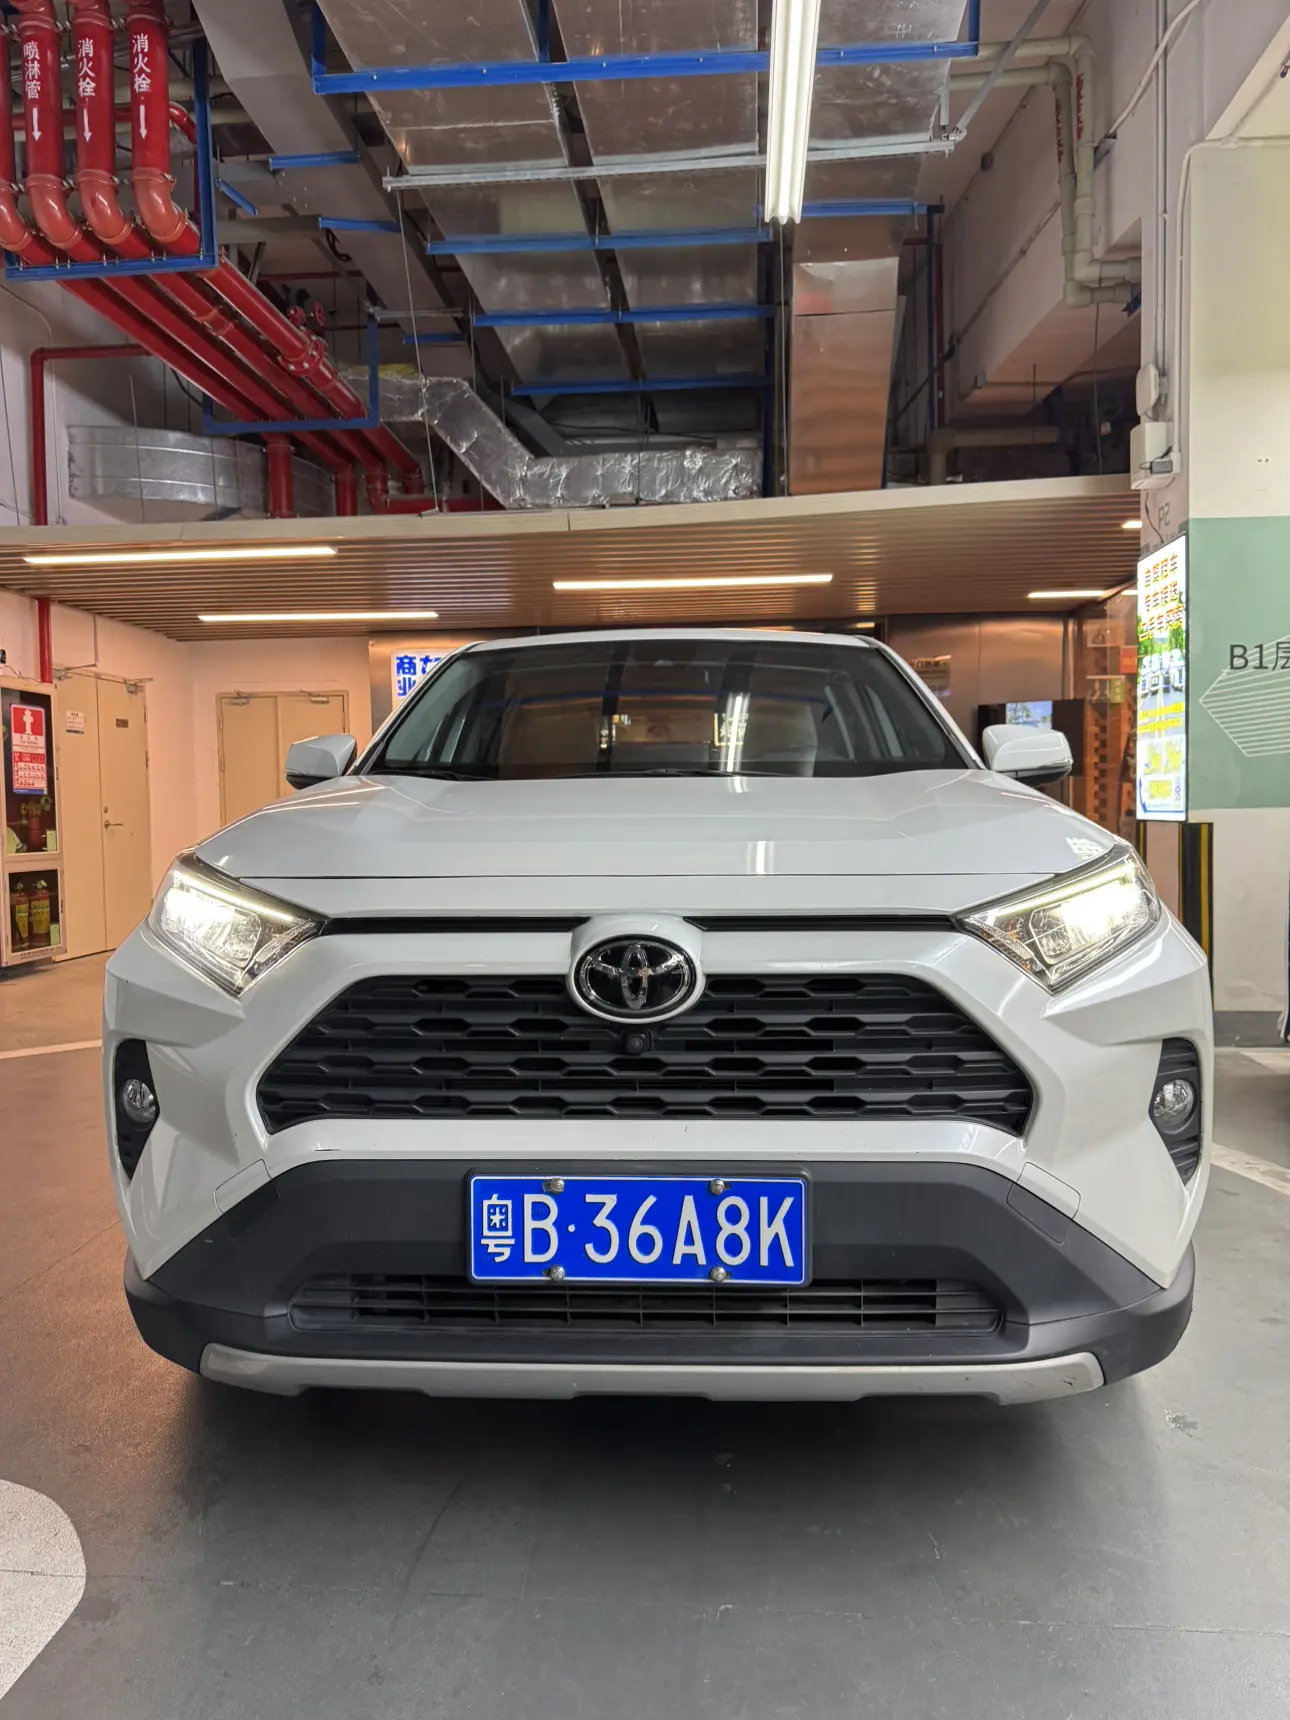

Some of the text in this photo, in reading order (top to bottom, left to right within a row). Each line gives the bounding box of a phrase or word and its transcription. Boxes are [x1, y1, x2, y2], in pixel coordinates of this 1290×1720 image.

[23, 41, 41, 99] 喷淋管
[78, 37, 96, 97] 消火栓
[132, 33, 152, 93] 消火栓
[1158, 501, 1171, 531] P2
[480, 1193, 795, 1267] 粤B·36A8K
